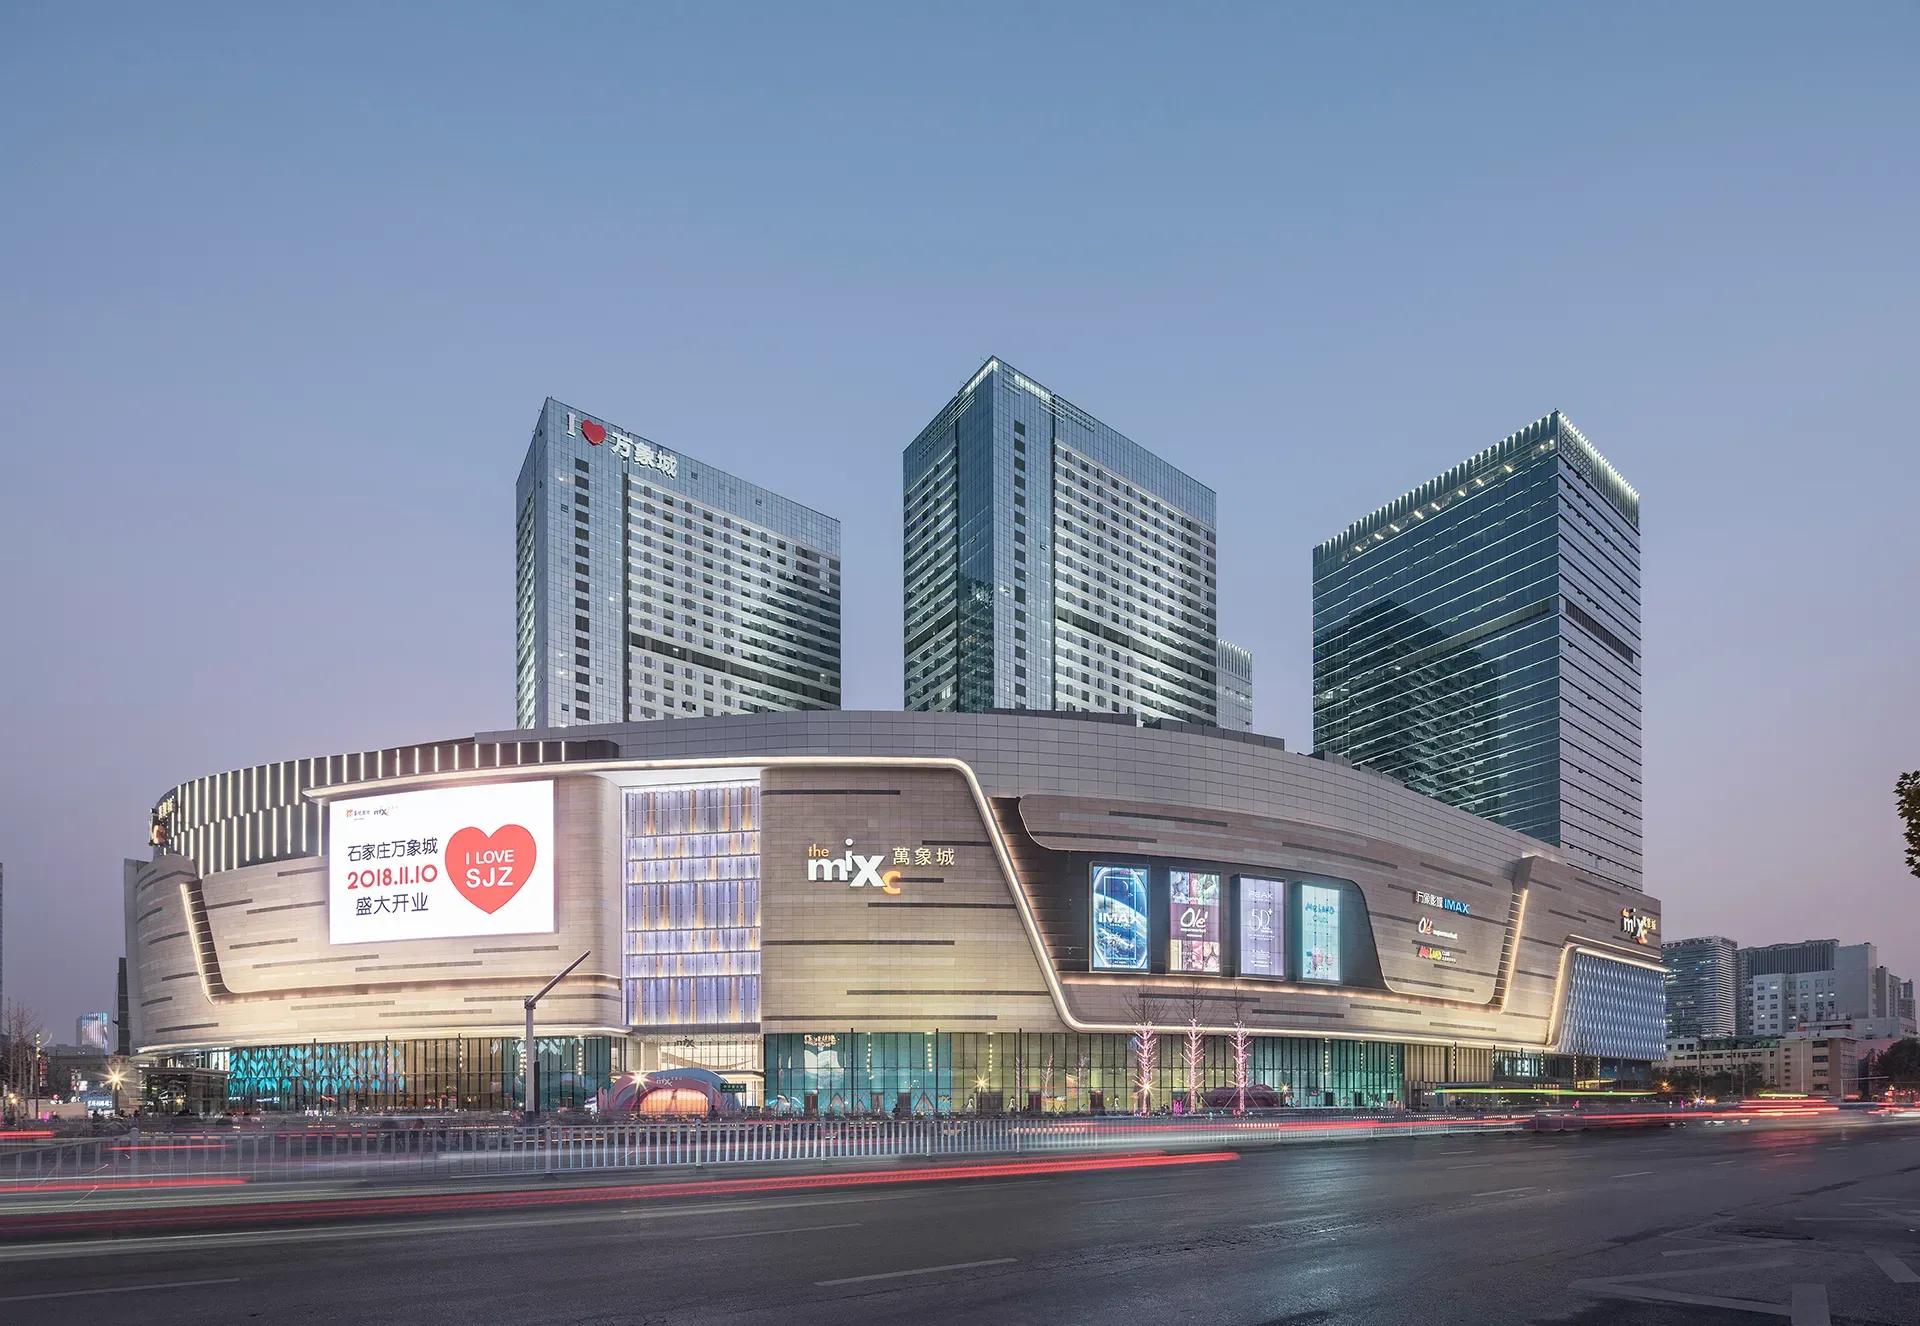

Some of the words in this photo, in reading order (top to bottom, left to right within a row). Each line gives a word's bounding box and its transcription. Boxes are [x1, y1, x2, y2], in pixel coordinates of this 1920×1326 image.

[567, 412, 576, 438] I
[610, 431, 678, 480] 万象城
[347, 837, 438, 862] 石家庄万象城
[465, 851, 470, 865] I
[475, 849, 515, 865] LOVE
[808, 843, 829, 857] the
[892, 847, 955, 866] 萬象城
[347, 864, 438, 890] 2018.11.10
[465, 866, 513, 888] SJZ
[355, 892, 429, 916] 盛大开业
[1444, 898, 1470, 914] IMAX
